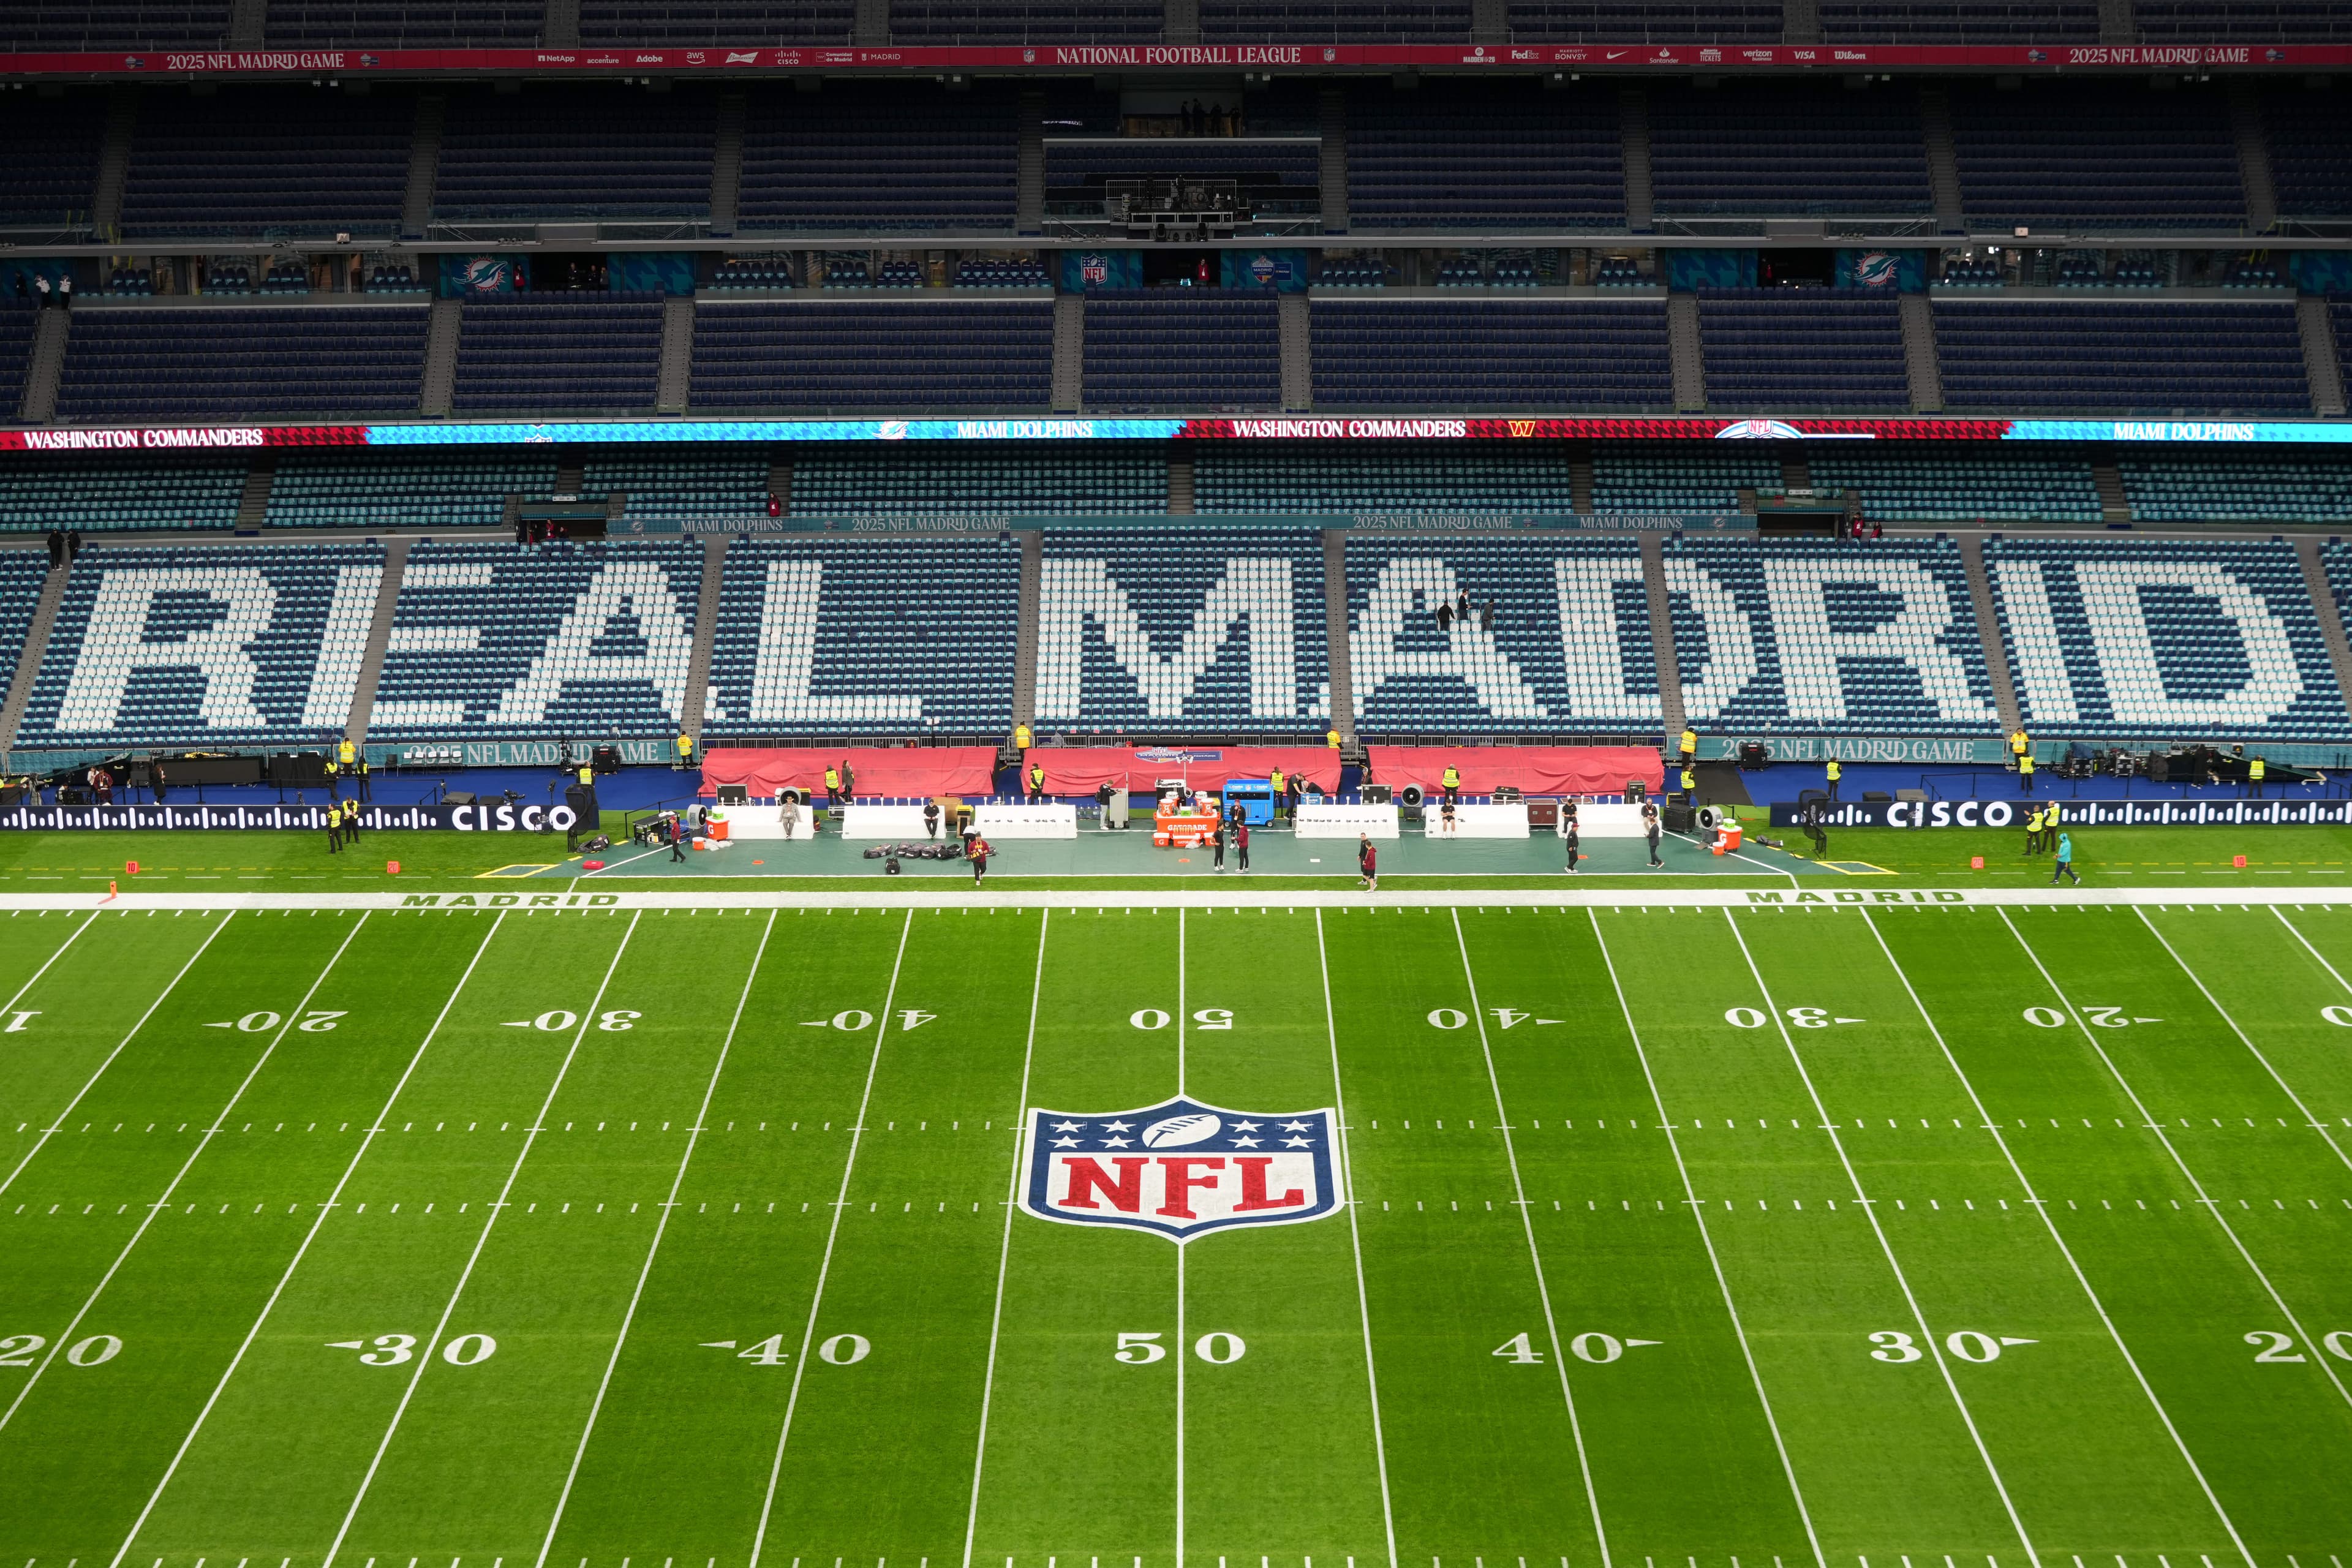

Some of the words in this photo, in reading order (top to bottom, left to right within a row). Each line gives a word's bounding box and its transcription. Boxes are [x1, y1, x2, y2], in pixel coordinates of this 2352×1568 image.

[167, 55, 205, 69] 2025
[208, 55, 236, 69] NFL
[239, 54, 298, 69] MADRID
[301, 53, 344, 68] GAME
[1057, 48, 1139, 64] NATIONAL
[1147, 47, 1231, 64] FOOTBALL
[1237, 47, 1300, 64] LEAGUE
[1512, 50, 1539, 59] FedEx
[2070, 48, 2108, 63] 2025
[2111, 48, 2138, 63] NFL
[2142, 48, 2200, 64] MADRID
[2205, 48, 2249, 63] GAME
[1084, 268, 1104, 281] NFL
[957, 421, 1007, 438] MIAMI
[1013, 420, 1093, 438] DOLPHINS
[1232, 420, 1344, 437] WASHINGTON
[1349, 420, 1466, 437] COMMANDERS
[2113, 423, 2165, 440] MIAMI
[2171, 423, 2255, 440] DOLPHINS
[24, 430, 138, 449] WASHINGTON
[143, 428, 263, 448] COMMANDERS
[680, 520, 718, 532] MIAMI
[723, 519, 783, 532] DOLPHINS
[852, 518, 886, 531] 2025
[889, 518, 913, 530] NFL
[916, 518, 968, 532] MADRID
[971, 517, 1010, 530] GAME
[1353, 516, 1387, 529] 2025
[1390, 516, 1414, 528] NFL
[1417, 516, 1470, 530] MADRID
[1473, 516, 1512, 529] GAME
[1580, 517, 1618, 529] MIAMI
[1623, 517, 1683, 529] DOLPHINS
[467, 744, 506, 764] NFL
[598, 742, 658, 761] AME
[1780, 739, 1819, 758] NFL
[1823, 740, 1908, 761] MADRID
[1912, 741, 1975, 760] GAME
[452, 805, 577, 831] CISCO
[1887, 801, 2013, 827] CISCO
[708, 824, 714, 835] G
[1719, 834, 1727, 844] G
[127, 863, 135, 872] 10
[388, 863, 397, 872] 20
[2236, 857, 2244, 866] 10
[401, 895, 620, 907] MADRID
[1745, 892, 1965, 903] MADRID
[1058, 1156, 1305, 1219] NFL
